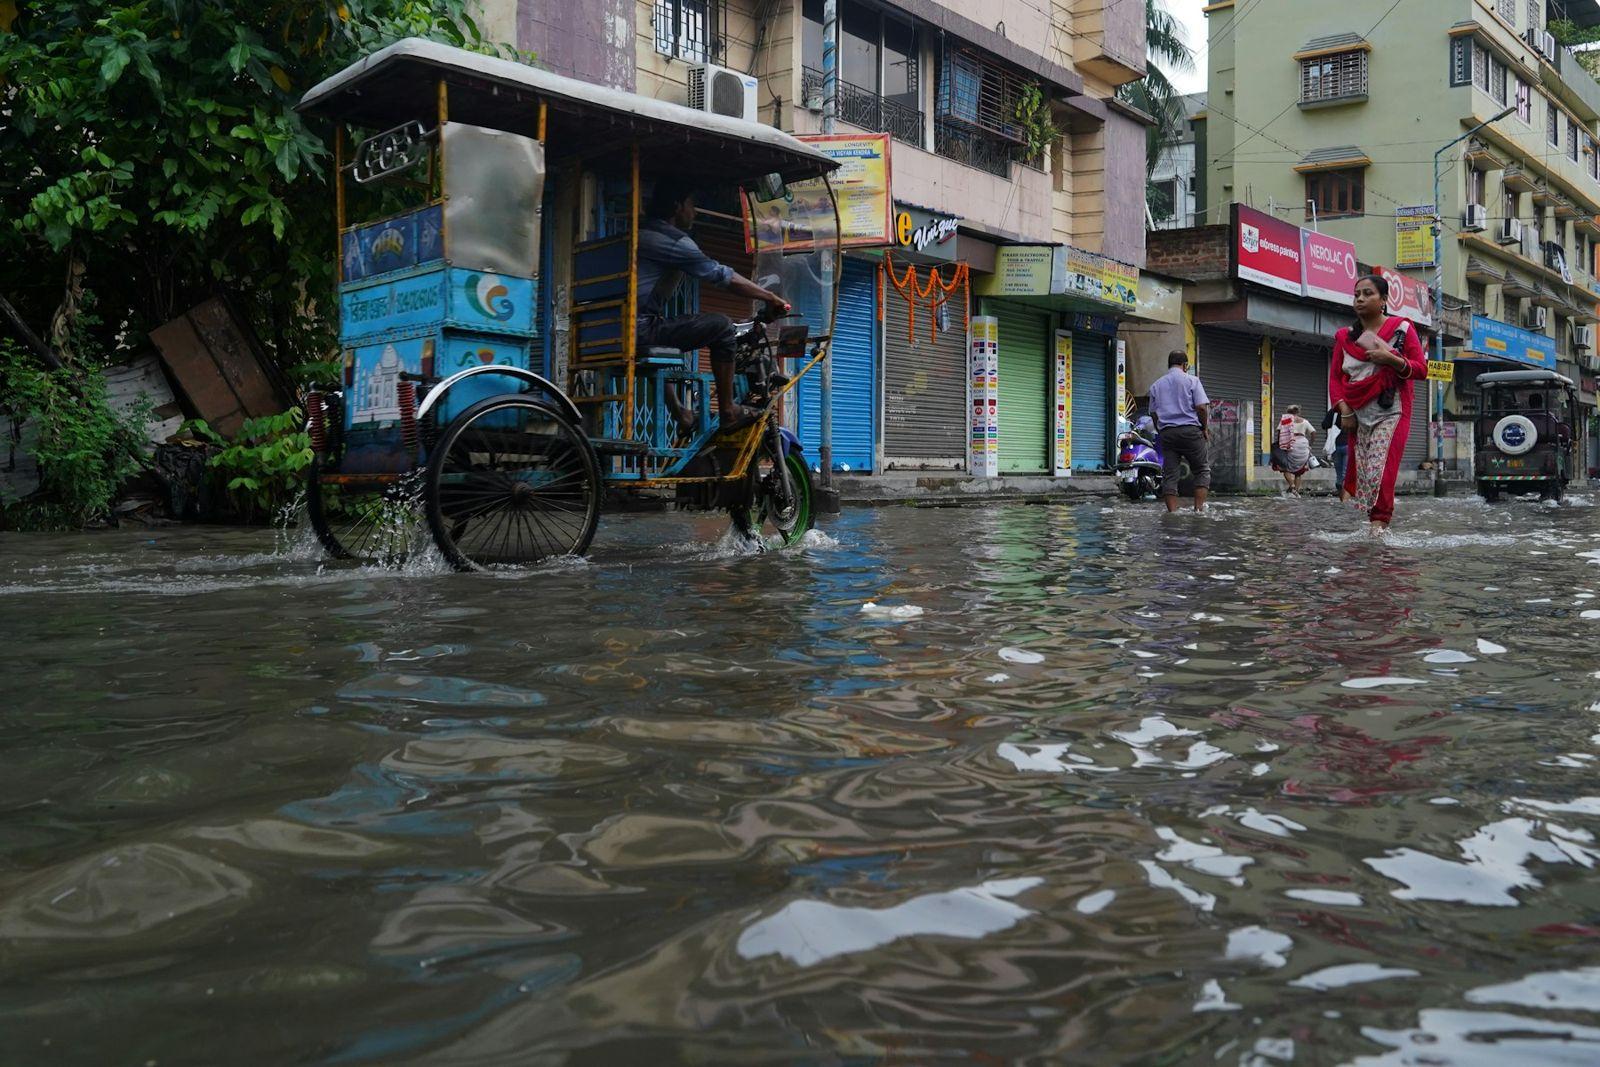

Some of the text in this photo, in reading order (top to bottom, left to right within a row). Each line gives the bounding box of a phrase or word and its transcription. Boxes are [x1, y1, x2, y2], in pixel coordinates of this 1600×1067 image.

[914, 218, 958, 252] Unique
[1259, 237, 1299, 263] express painting
[1310, 242, 1343, 265] NEROLAC
